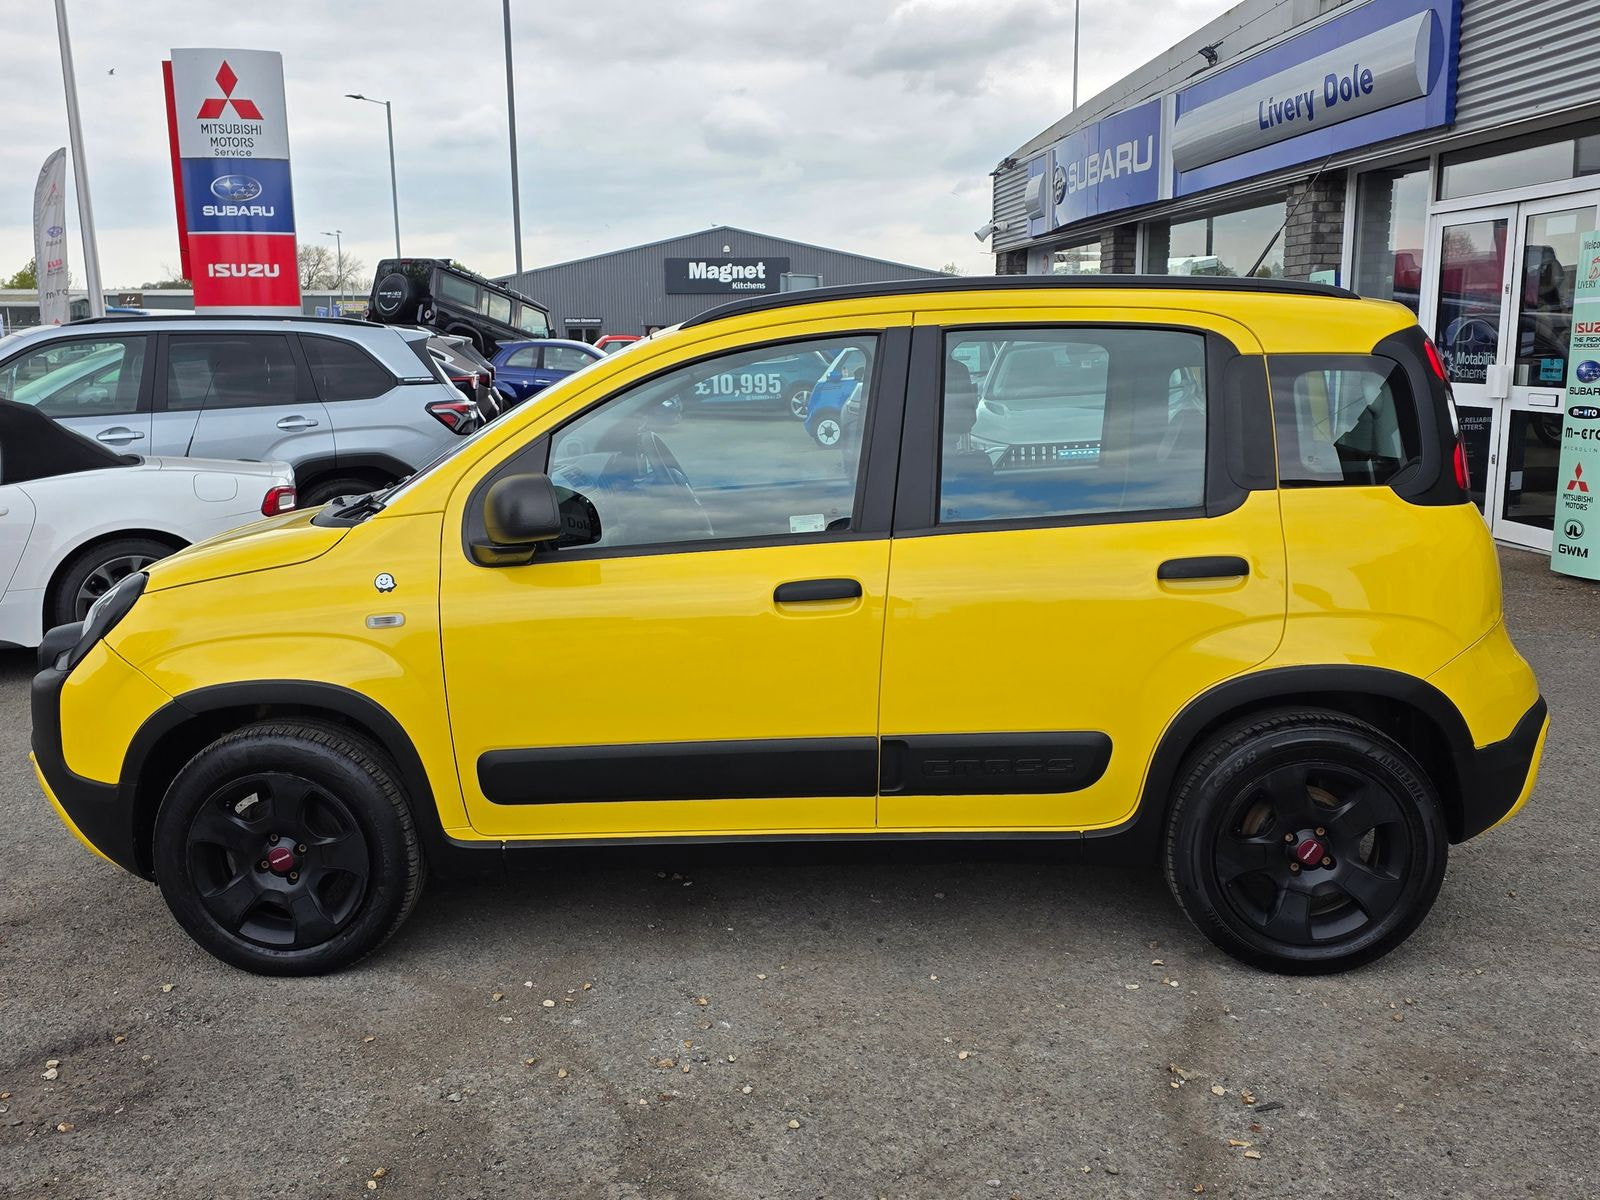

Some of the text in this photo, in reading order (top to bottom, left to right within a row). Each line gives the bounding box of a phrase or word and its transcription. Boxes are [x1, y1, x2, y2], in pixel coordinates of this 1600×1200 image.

[1258, 63, 1374, 131] Livery Dole
[200, 123, 262, 135] MITSUBISHI
[210, 136, 254, 148] MOTORS
[214, 148, 252, 157] Service
[1066, 134, 1153, 195] SUBARU
[202, 205, 275, 217] SUBARU
[208, 263, 280, 278] ISUZU
[688, 261, 766, 283] Magnet
[732, 281, 766, 290] Kitchens
[694, 373, 782, 397] £10,995
[1562, 493, 1594, 504] MITSUBISHI
[1565, 501, 1588, 511] MOTORS
[1558, 543, 1589, 558] GWM
